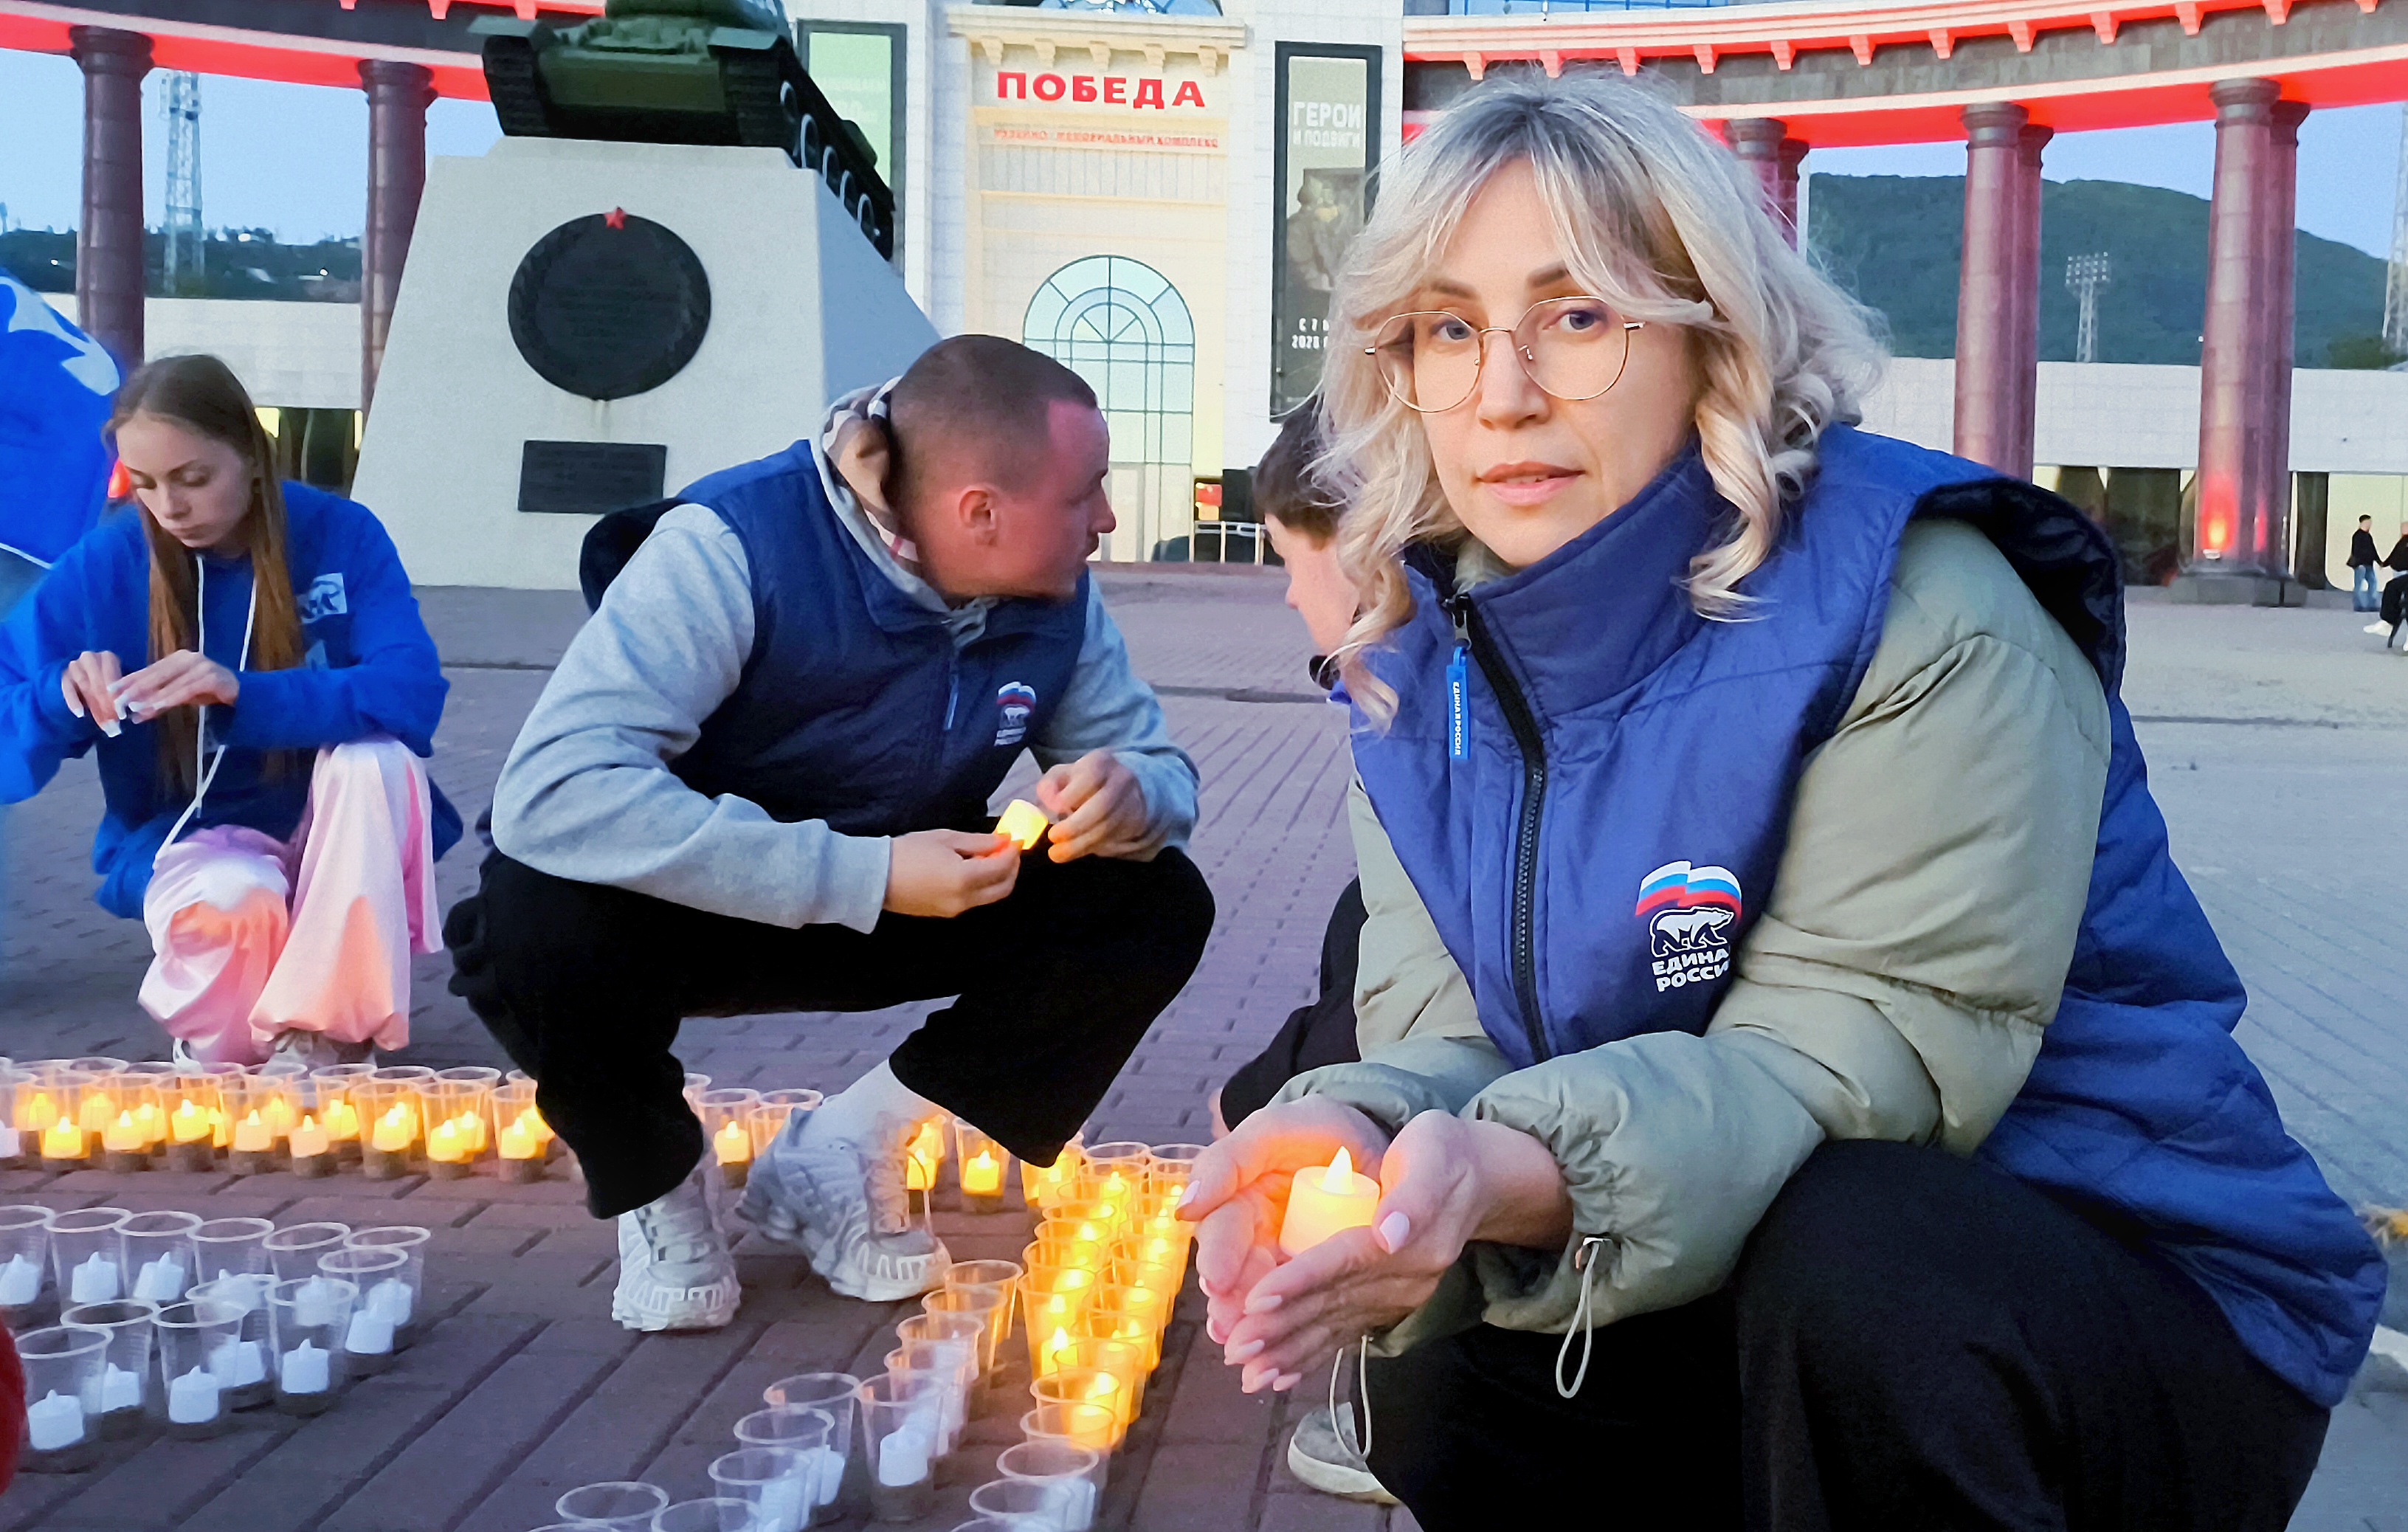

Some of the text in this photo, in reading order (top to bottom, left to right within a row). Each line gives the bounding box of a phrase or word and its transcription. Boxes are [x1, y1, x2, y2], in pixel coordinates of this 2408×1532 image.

[998, 72, 1205, 109] ПОБЕДА
[1293, 101, 1362, 128] ГЕРОИ
[1453, 682, 1461, 720] ЕДИНАЯ
[1652, 948, 1730, 976] ЕДИНА
[1656, 960, 1730, 992] РОССИ
